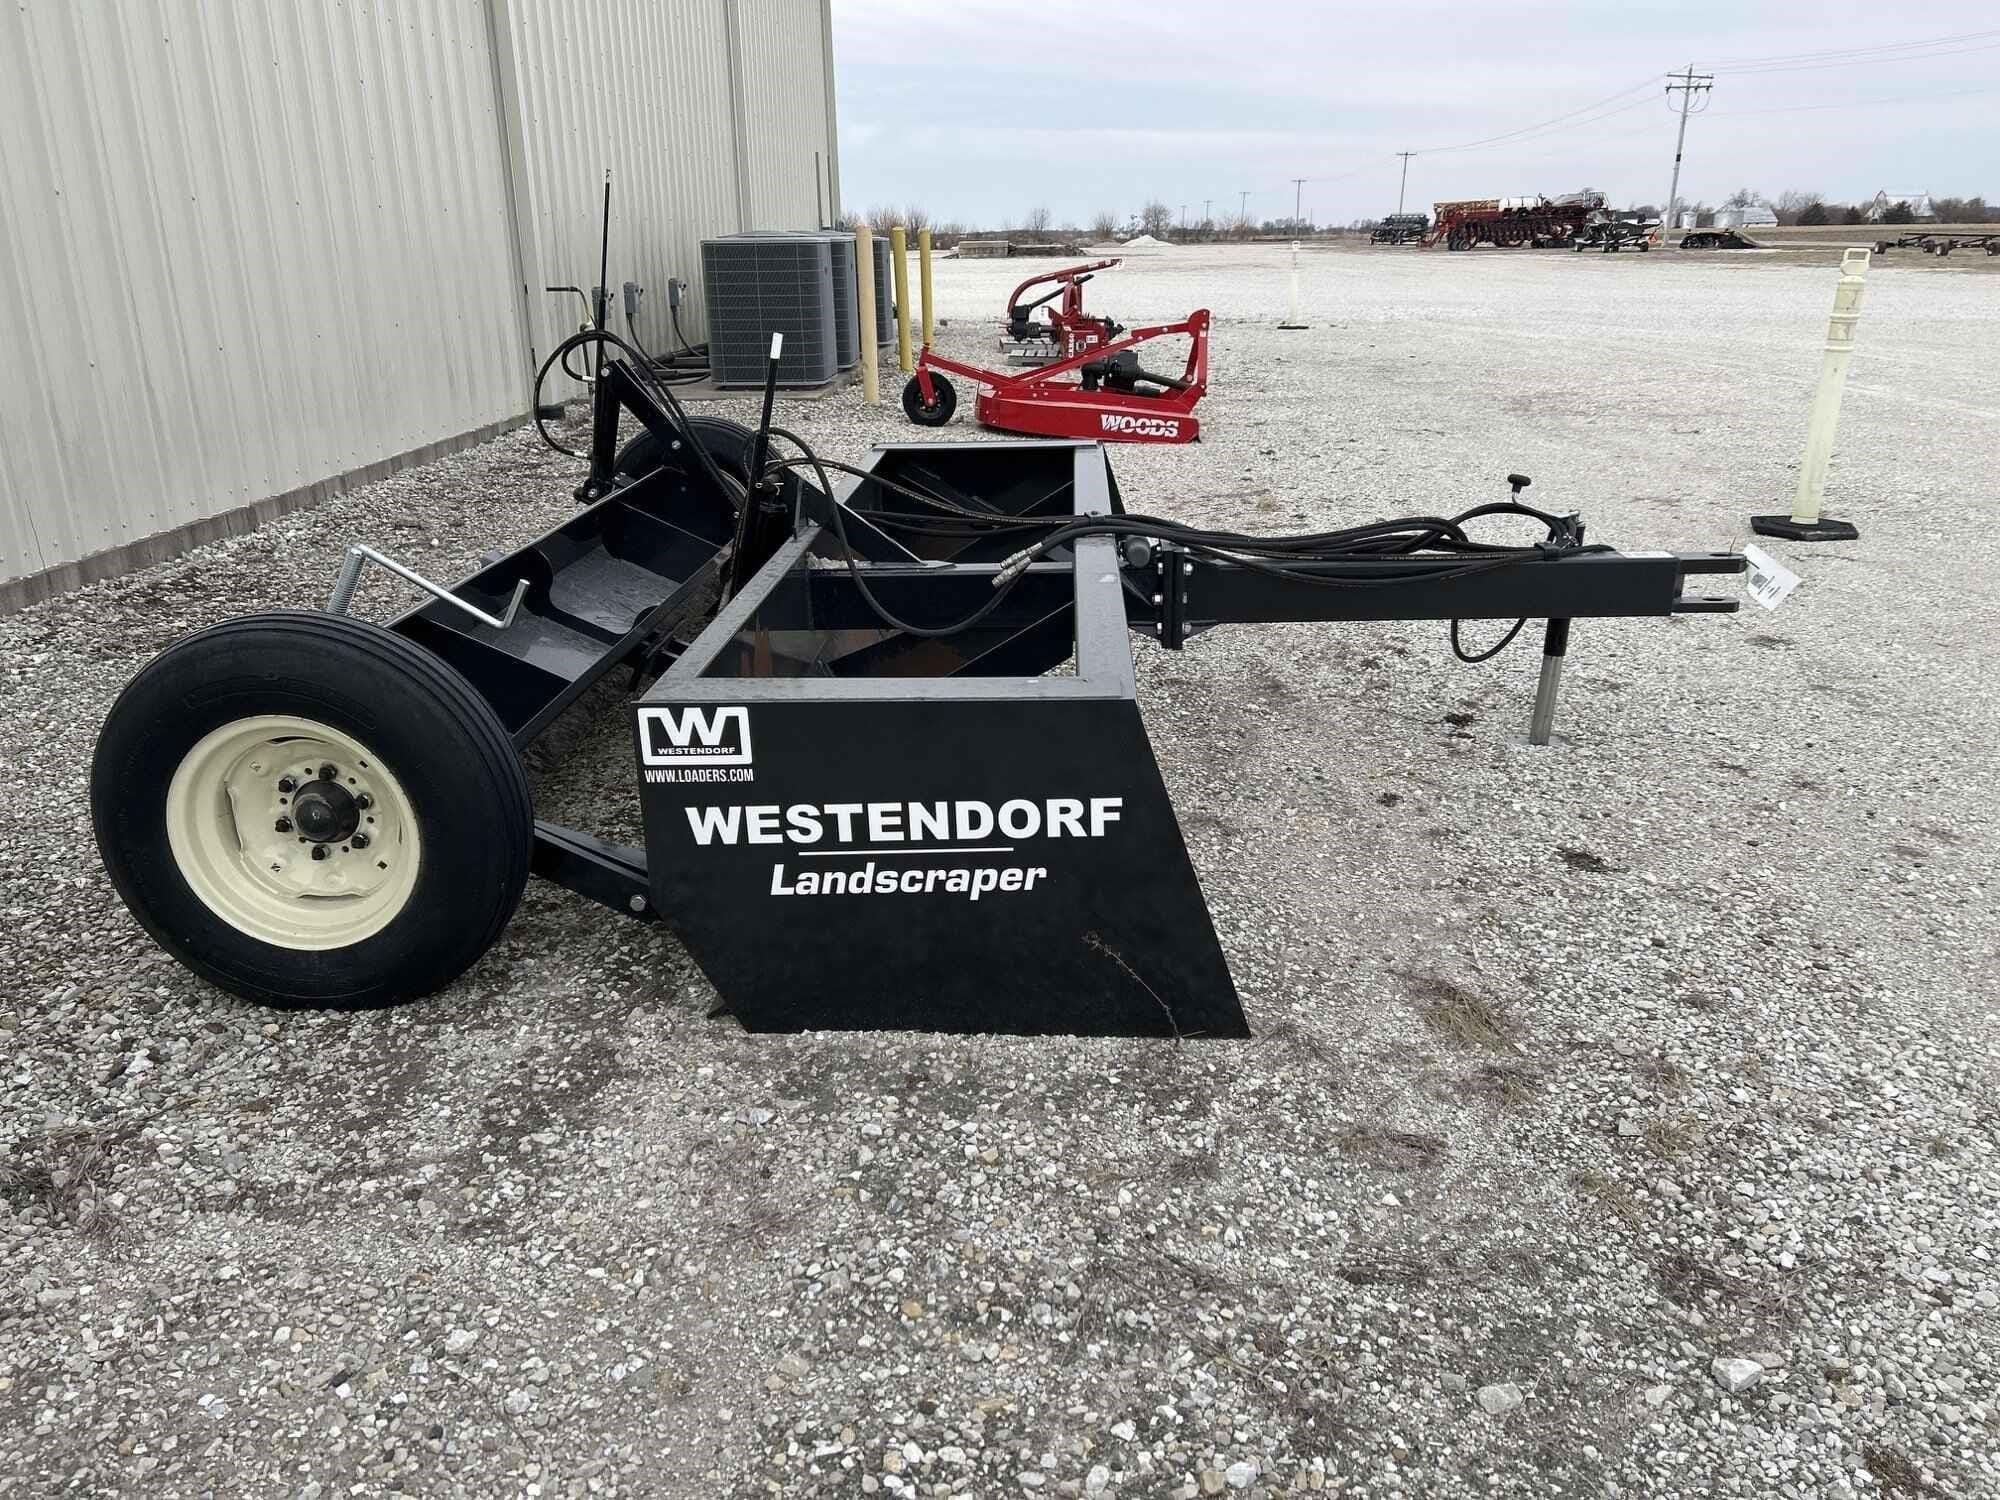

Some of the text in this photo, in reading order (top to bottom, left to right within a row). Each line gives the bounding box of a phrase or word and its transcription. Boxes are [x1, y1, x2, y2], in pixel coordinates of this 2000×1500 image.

[1100, 414, 1179, 438] WOODS
[657, 747, 736, 755] WESTENDORF
[644, 769, 754, 783] WWW.LOADERS.COM
[685, 797, 1123, 846] WESTENDORF
[770, 861, 1048, 901] Landscraper
